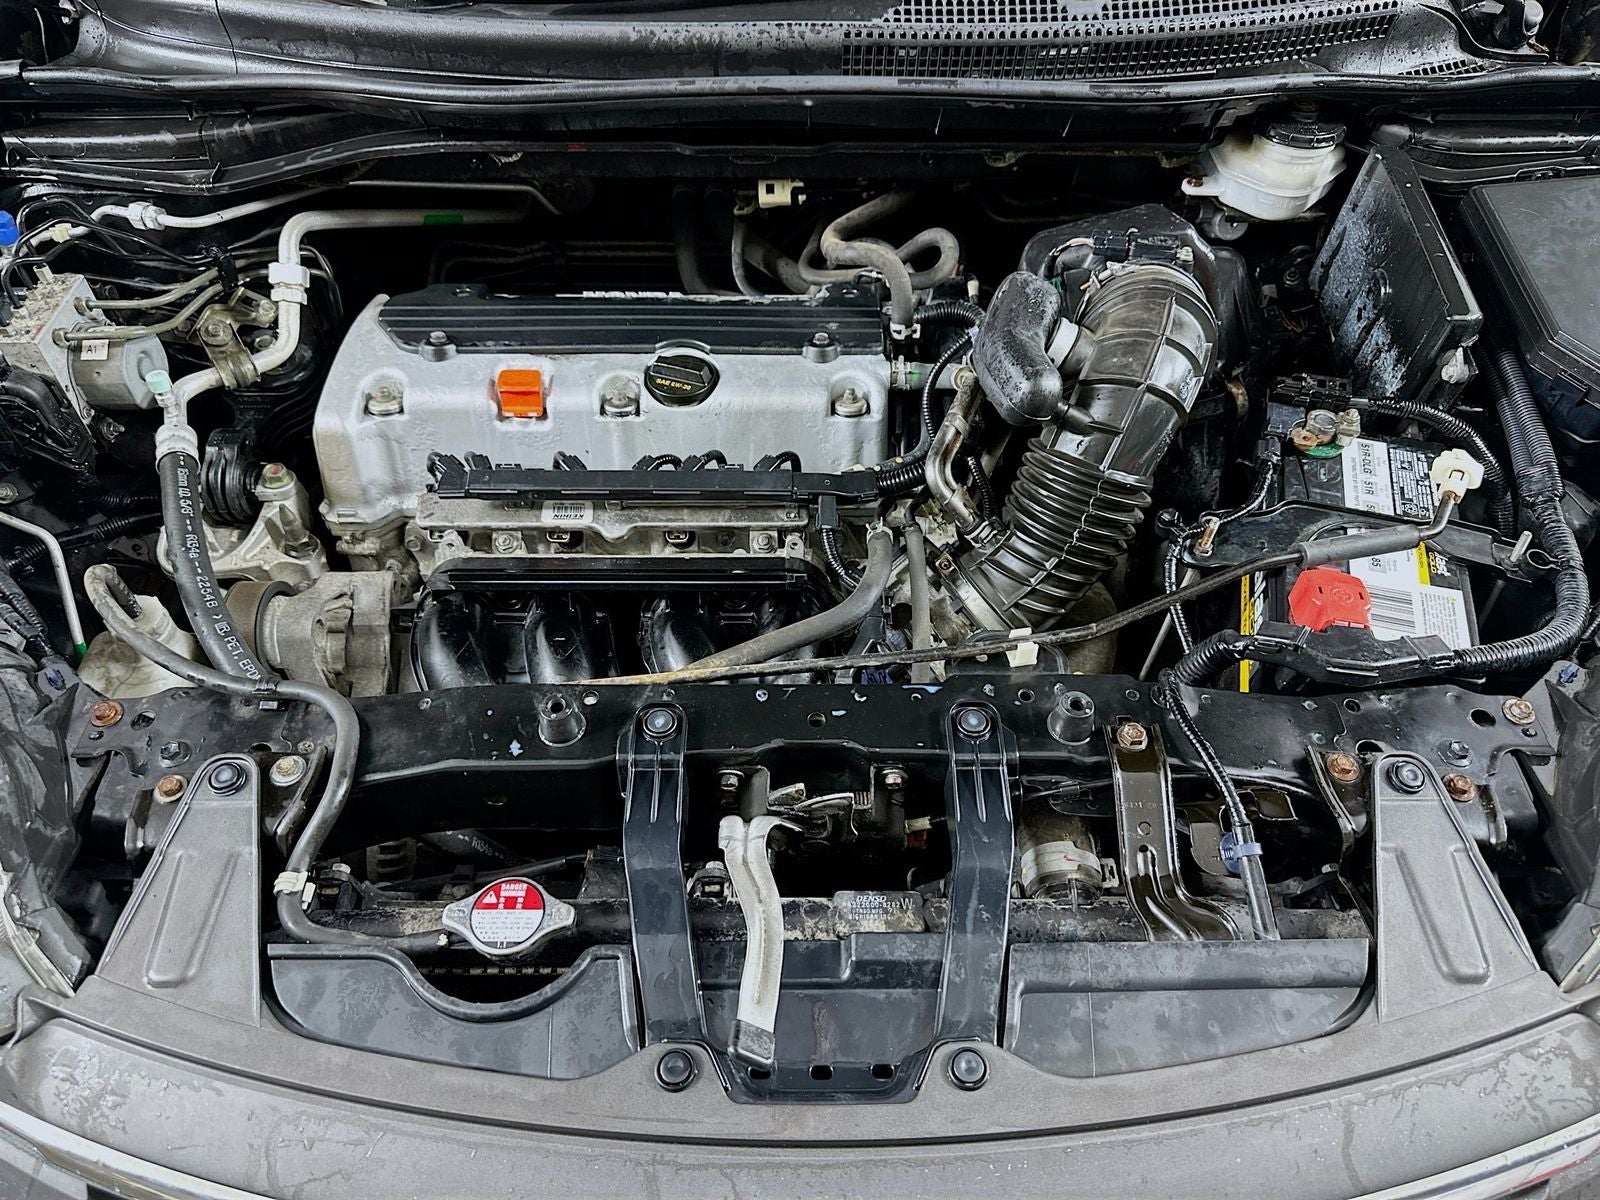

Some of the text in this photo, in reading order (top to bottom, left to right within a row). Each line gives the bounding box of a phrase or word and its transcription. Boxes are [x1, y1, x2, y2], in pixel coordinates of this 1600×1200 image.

[1361, 443, 1373, 474] 51R-DLG
[1363, 480, 1375, 496] 51R
[1371, 556, 1382, 568] 85
[1429, 552, 1437, 574] GOLD
